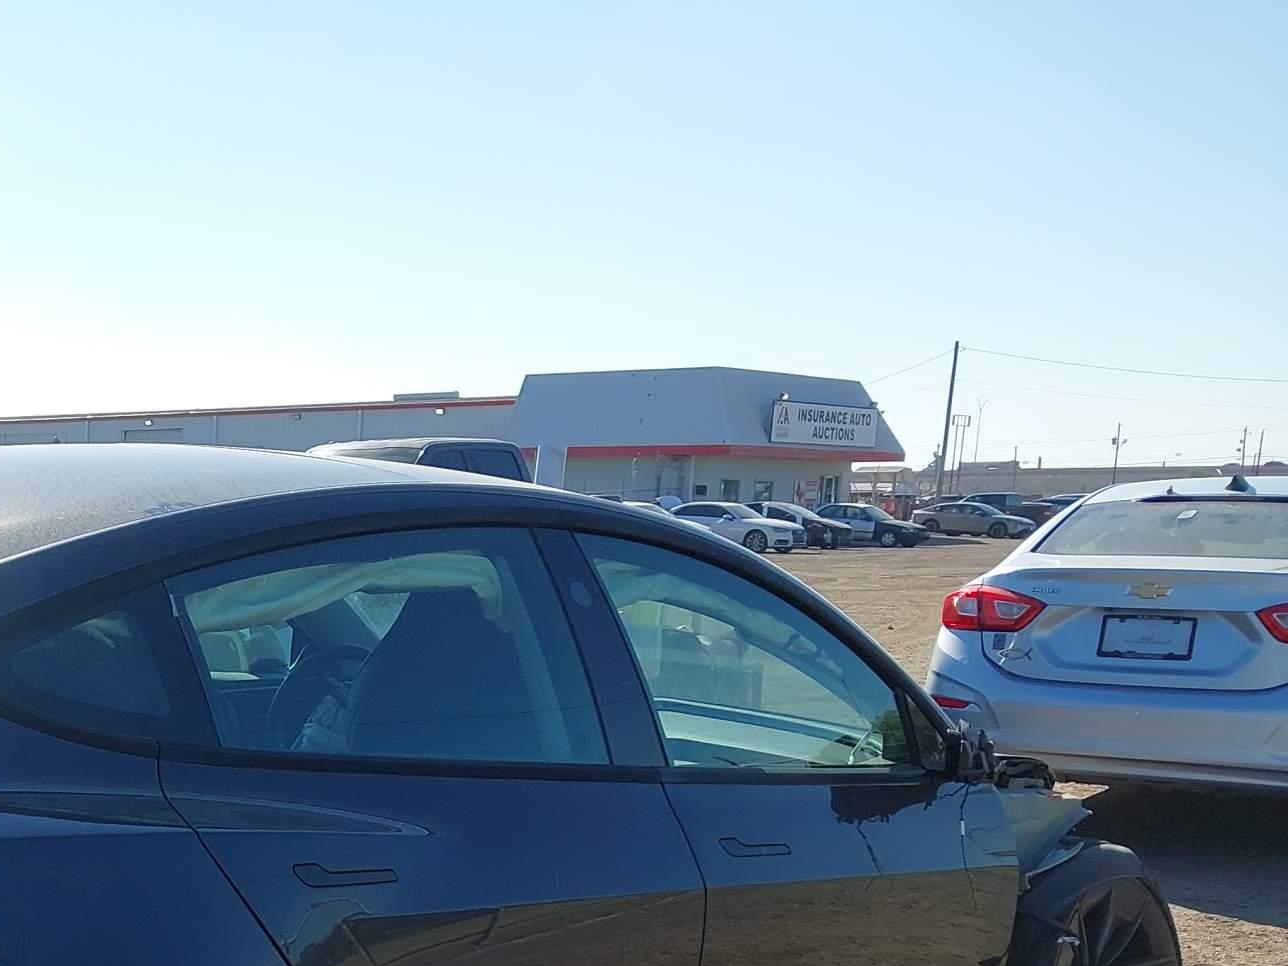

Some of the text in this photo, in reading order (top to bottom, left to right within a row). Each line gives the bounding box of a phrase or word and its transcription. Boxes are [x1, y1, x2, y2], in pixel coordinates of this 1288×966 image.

[798, 408, 871, 426] INSURANCE AUTO
[812, 426, 855, 441] AUCTIONS
